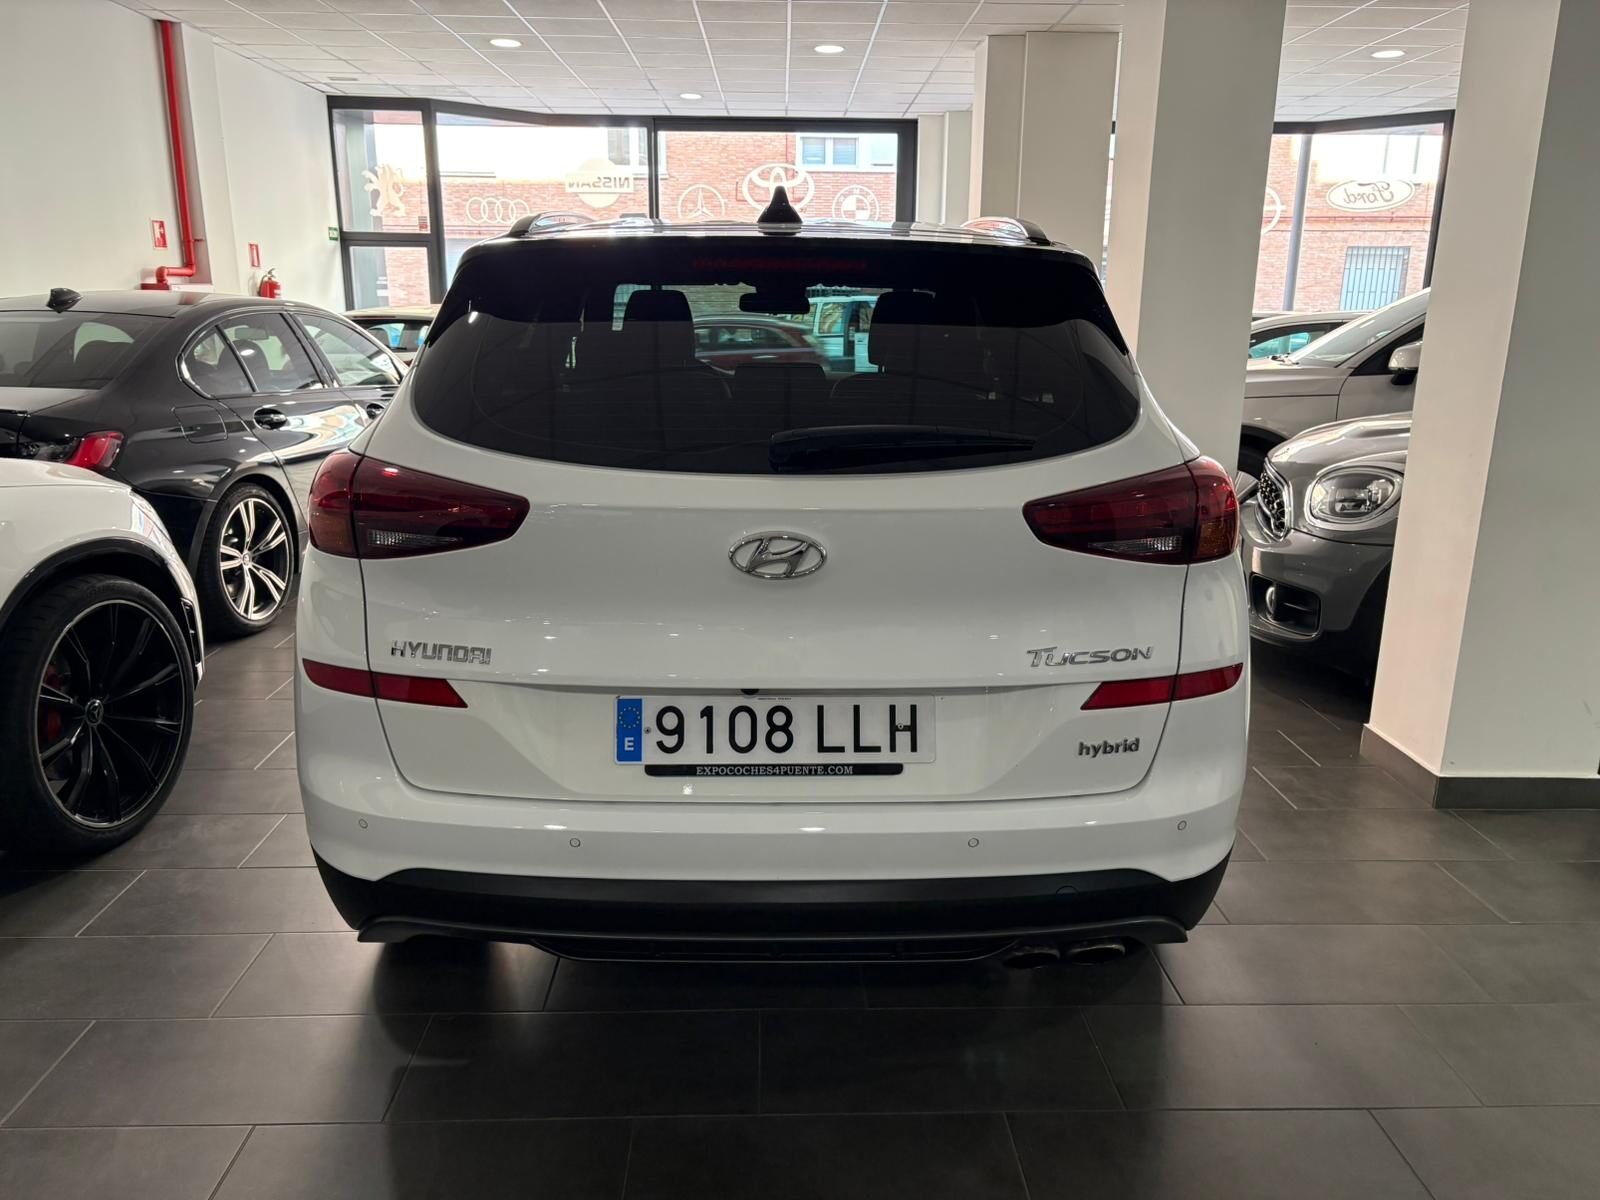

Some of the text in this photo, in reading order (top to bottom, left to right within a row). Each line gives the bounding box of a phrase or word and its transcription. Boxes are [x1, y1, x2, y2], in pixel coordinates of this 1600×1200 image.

[391, 640, 492, 665] HYUNDAI
[656, 704, 917, 754] 9108 LLH
[624, 736, 635, 751] E
[1078, 737, 1140, 758] hybrid
[696, 765, 853, 776] EXPOCOCHES4PUENTE.COM
